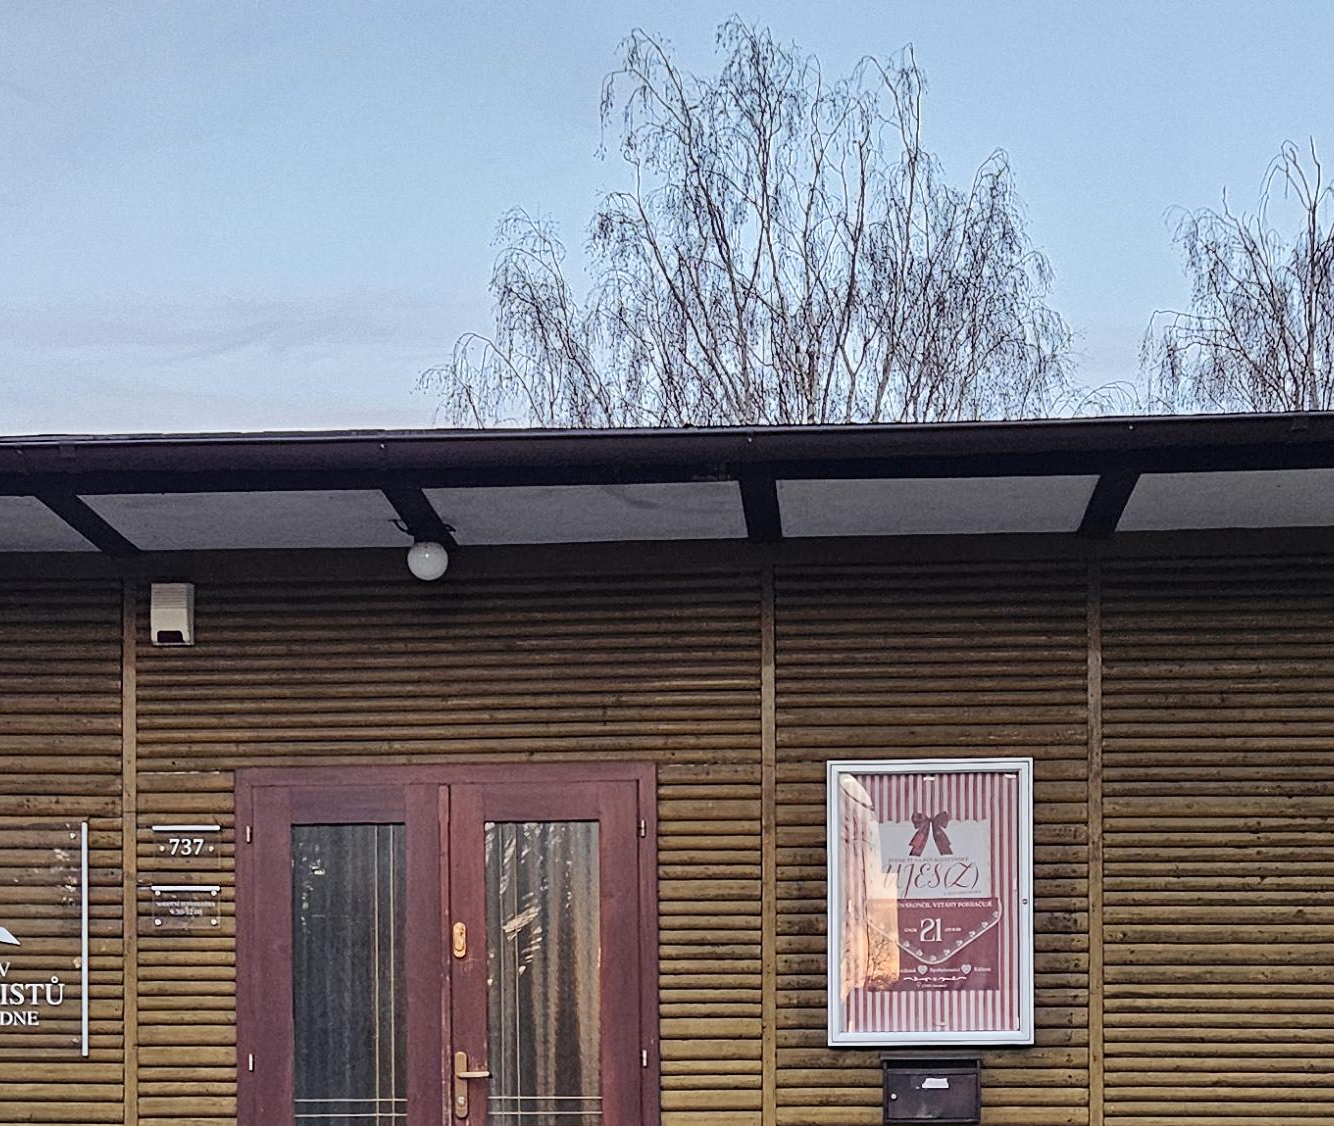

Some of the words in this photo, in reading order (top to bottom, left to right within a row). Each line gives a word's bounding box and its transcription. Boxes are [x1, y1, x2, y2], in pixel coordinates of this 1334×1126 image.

[169, 838, 204, 856] 737
[920, 917, 943, 942] 21
[0, 1010, 40, 1026] DNE
